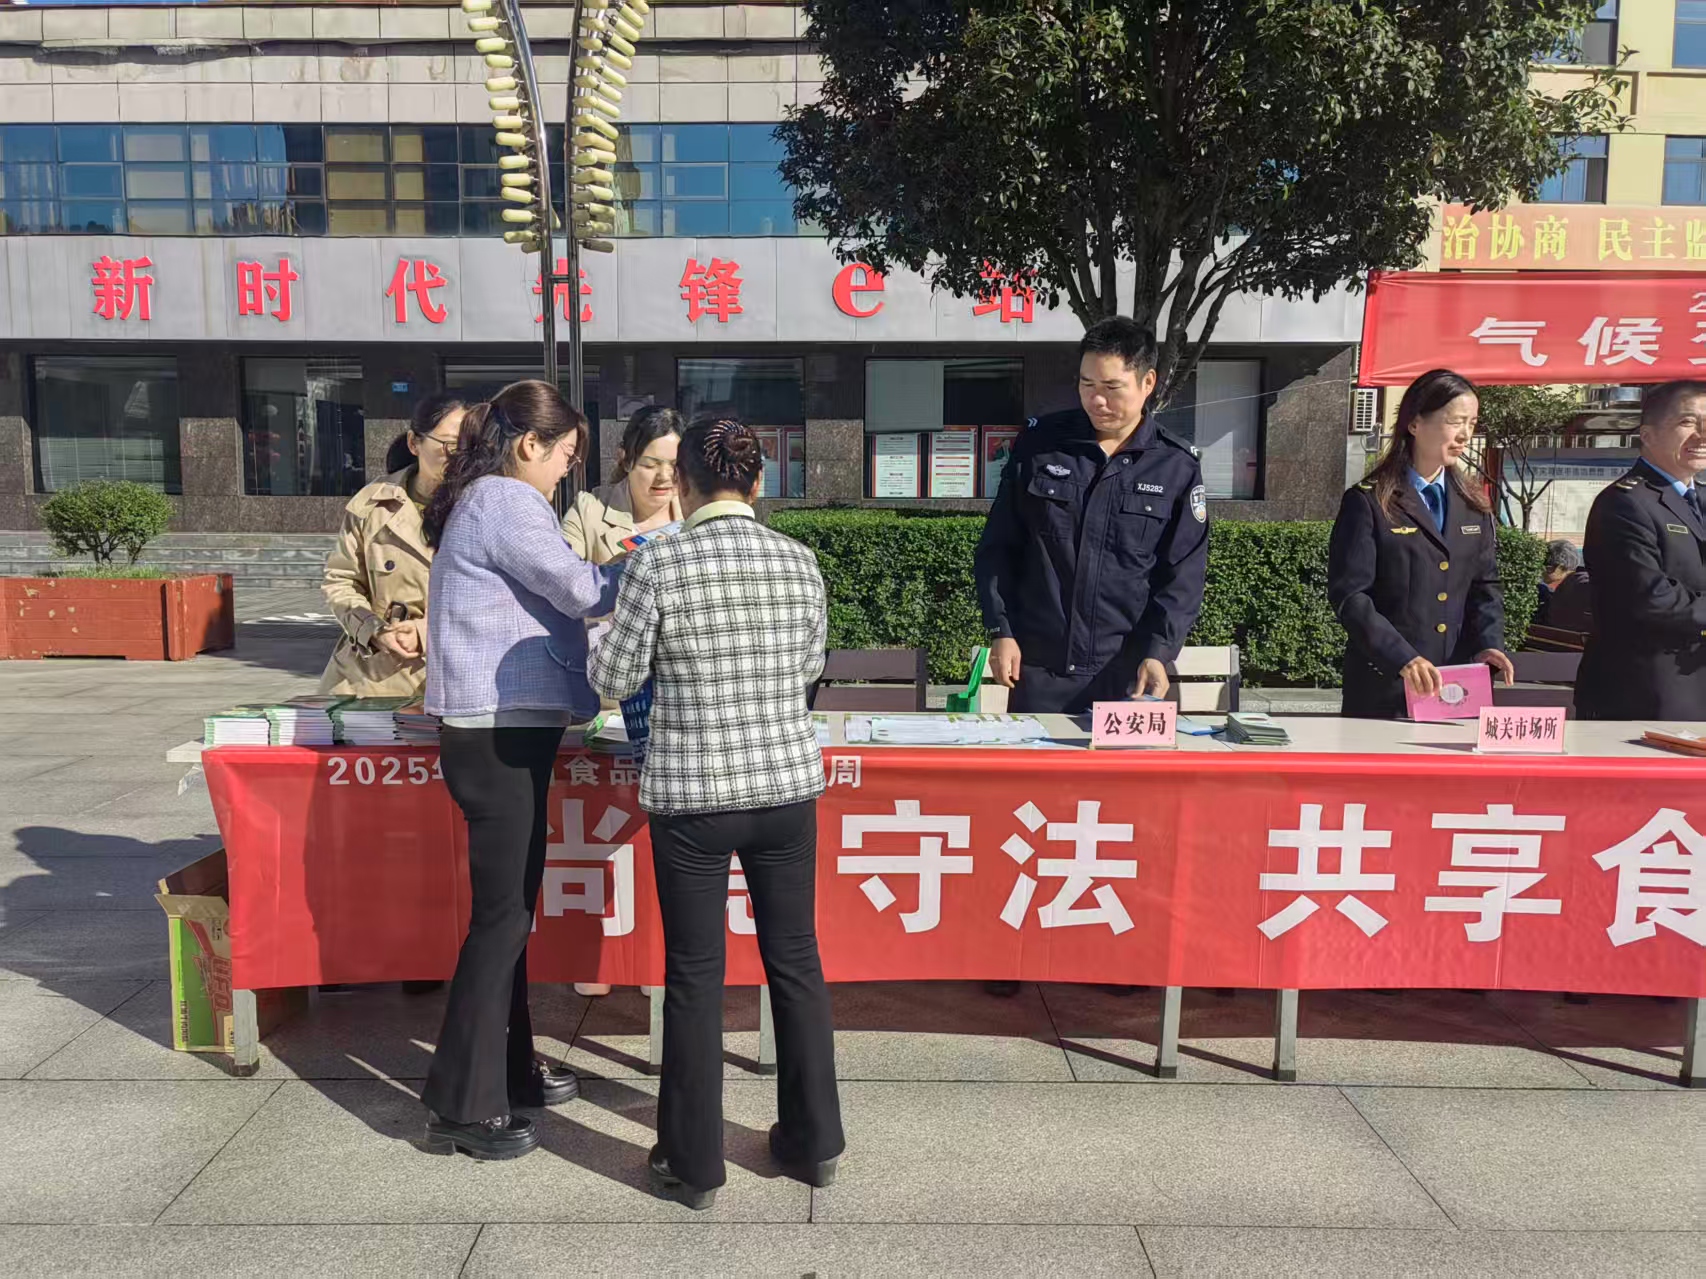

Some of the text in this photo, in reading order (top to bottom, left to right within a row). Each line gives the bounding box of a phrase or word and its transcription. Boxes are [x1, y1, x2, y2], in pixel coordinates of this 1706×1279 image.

[1443, 213, 1569, 262] 治协商
[1468, 316, 1706, 367] 气候
[1137, 483, 1164, 493] XJ5282
[1103, 711, 1167, 736] 公安局
[1485, 716, 1557, 741] 城关市场所
[551, 755, 640, 787] 食品
[827, 755, 862, 788] 周
[1256, 803, 1706, 947] 共享食
